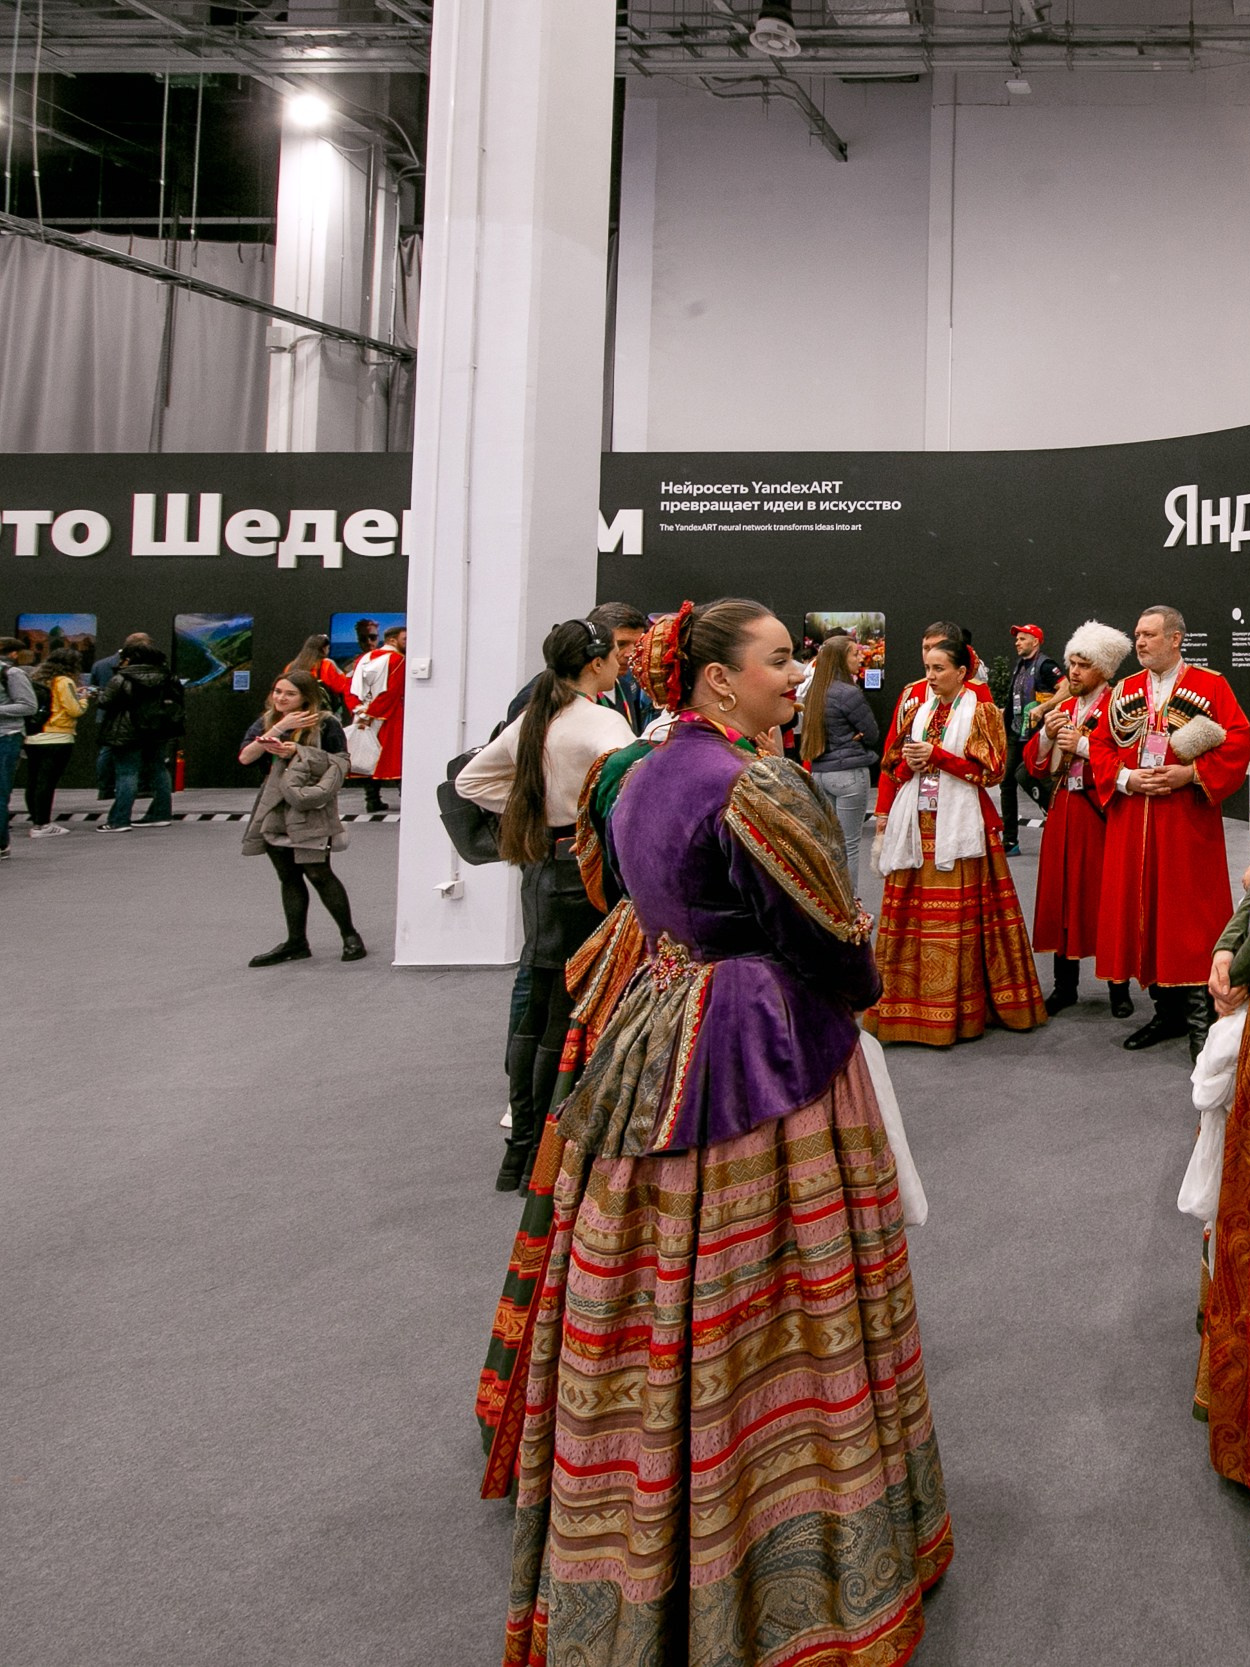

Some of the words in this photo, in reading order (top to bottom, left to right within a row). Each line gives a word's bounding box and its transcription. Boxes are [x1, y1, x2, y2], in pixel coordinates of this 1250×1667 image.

[660, 481, 749, 497] Нейросеть
[752, 480, 843, 494] YandexART
[660, 500, 761, 514] превращает
[763, 500, 804, 513] идеи
[806, 500, 817, 511] в
[819, 500, 902, 514] искусство
[0, 508, 111, 557] то
[659, 523, 674, 532] The
[675, 523, 718, 532] YandexART
[718, 523, 742, 532] neural
[742, 523, 773, 532] network
[773, 523, 814, 531] transforms
[815, 523, 835, 531] ideas
[835, 523, 850, 531] into
[851, 523, 862, 531] art
